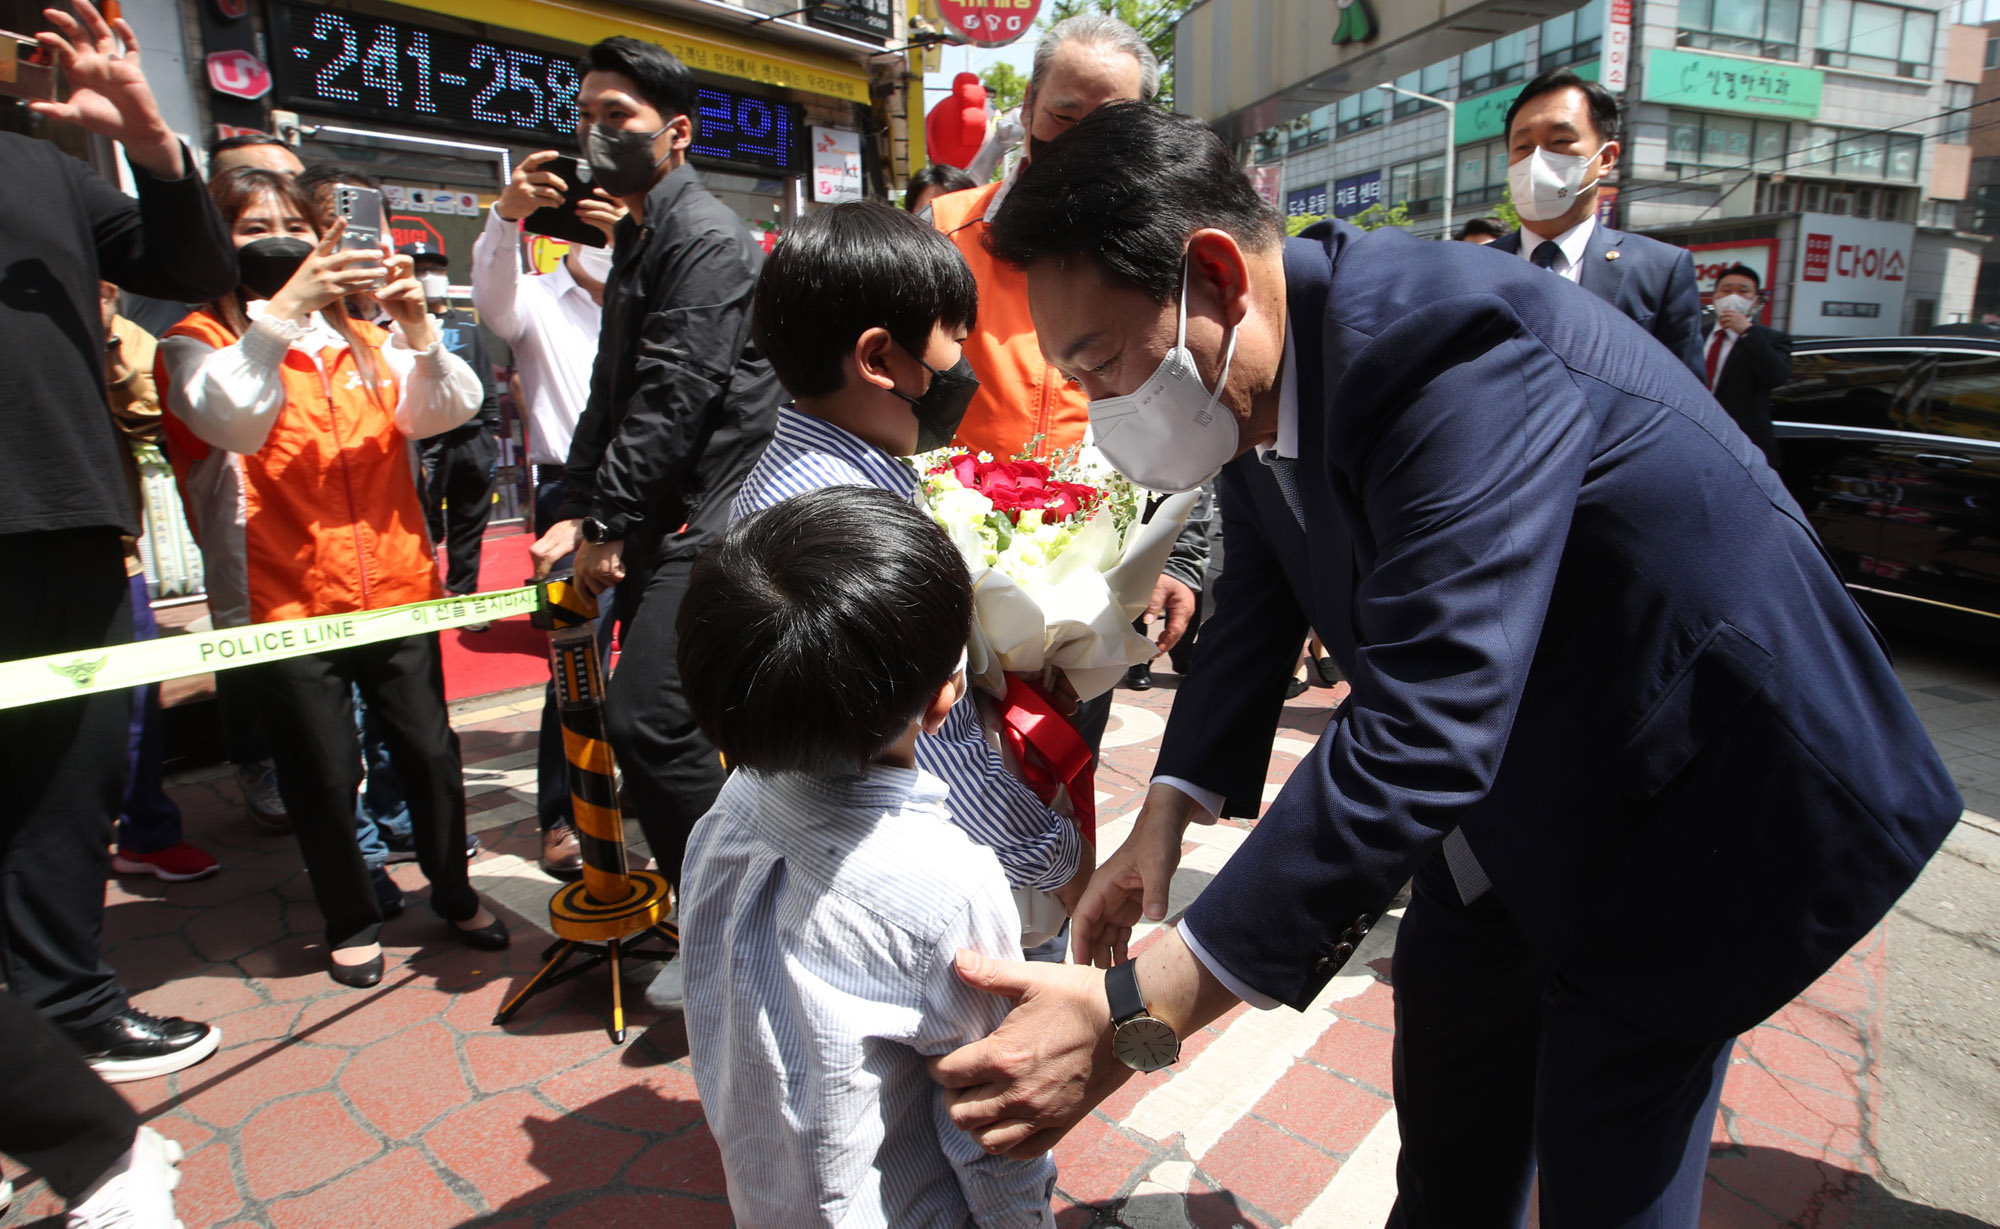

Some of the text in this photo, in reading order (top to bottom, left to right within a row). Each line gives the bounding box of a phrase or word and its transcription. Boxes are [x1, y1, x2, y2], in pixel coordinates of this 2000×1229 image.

[1609, 31, 1627, 83] 다이소
[1836, 244, 1905, 282] 다이소
[411, 608, 429, 625] 이
[435, 601, 466, 621] 선을
[201, 620, 356, 662] POLICE LINE
